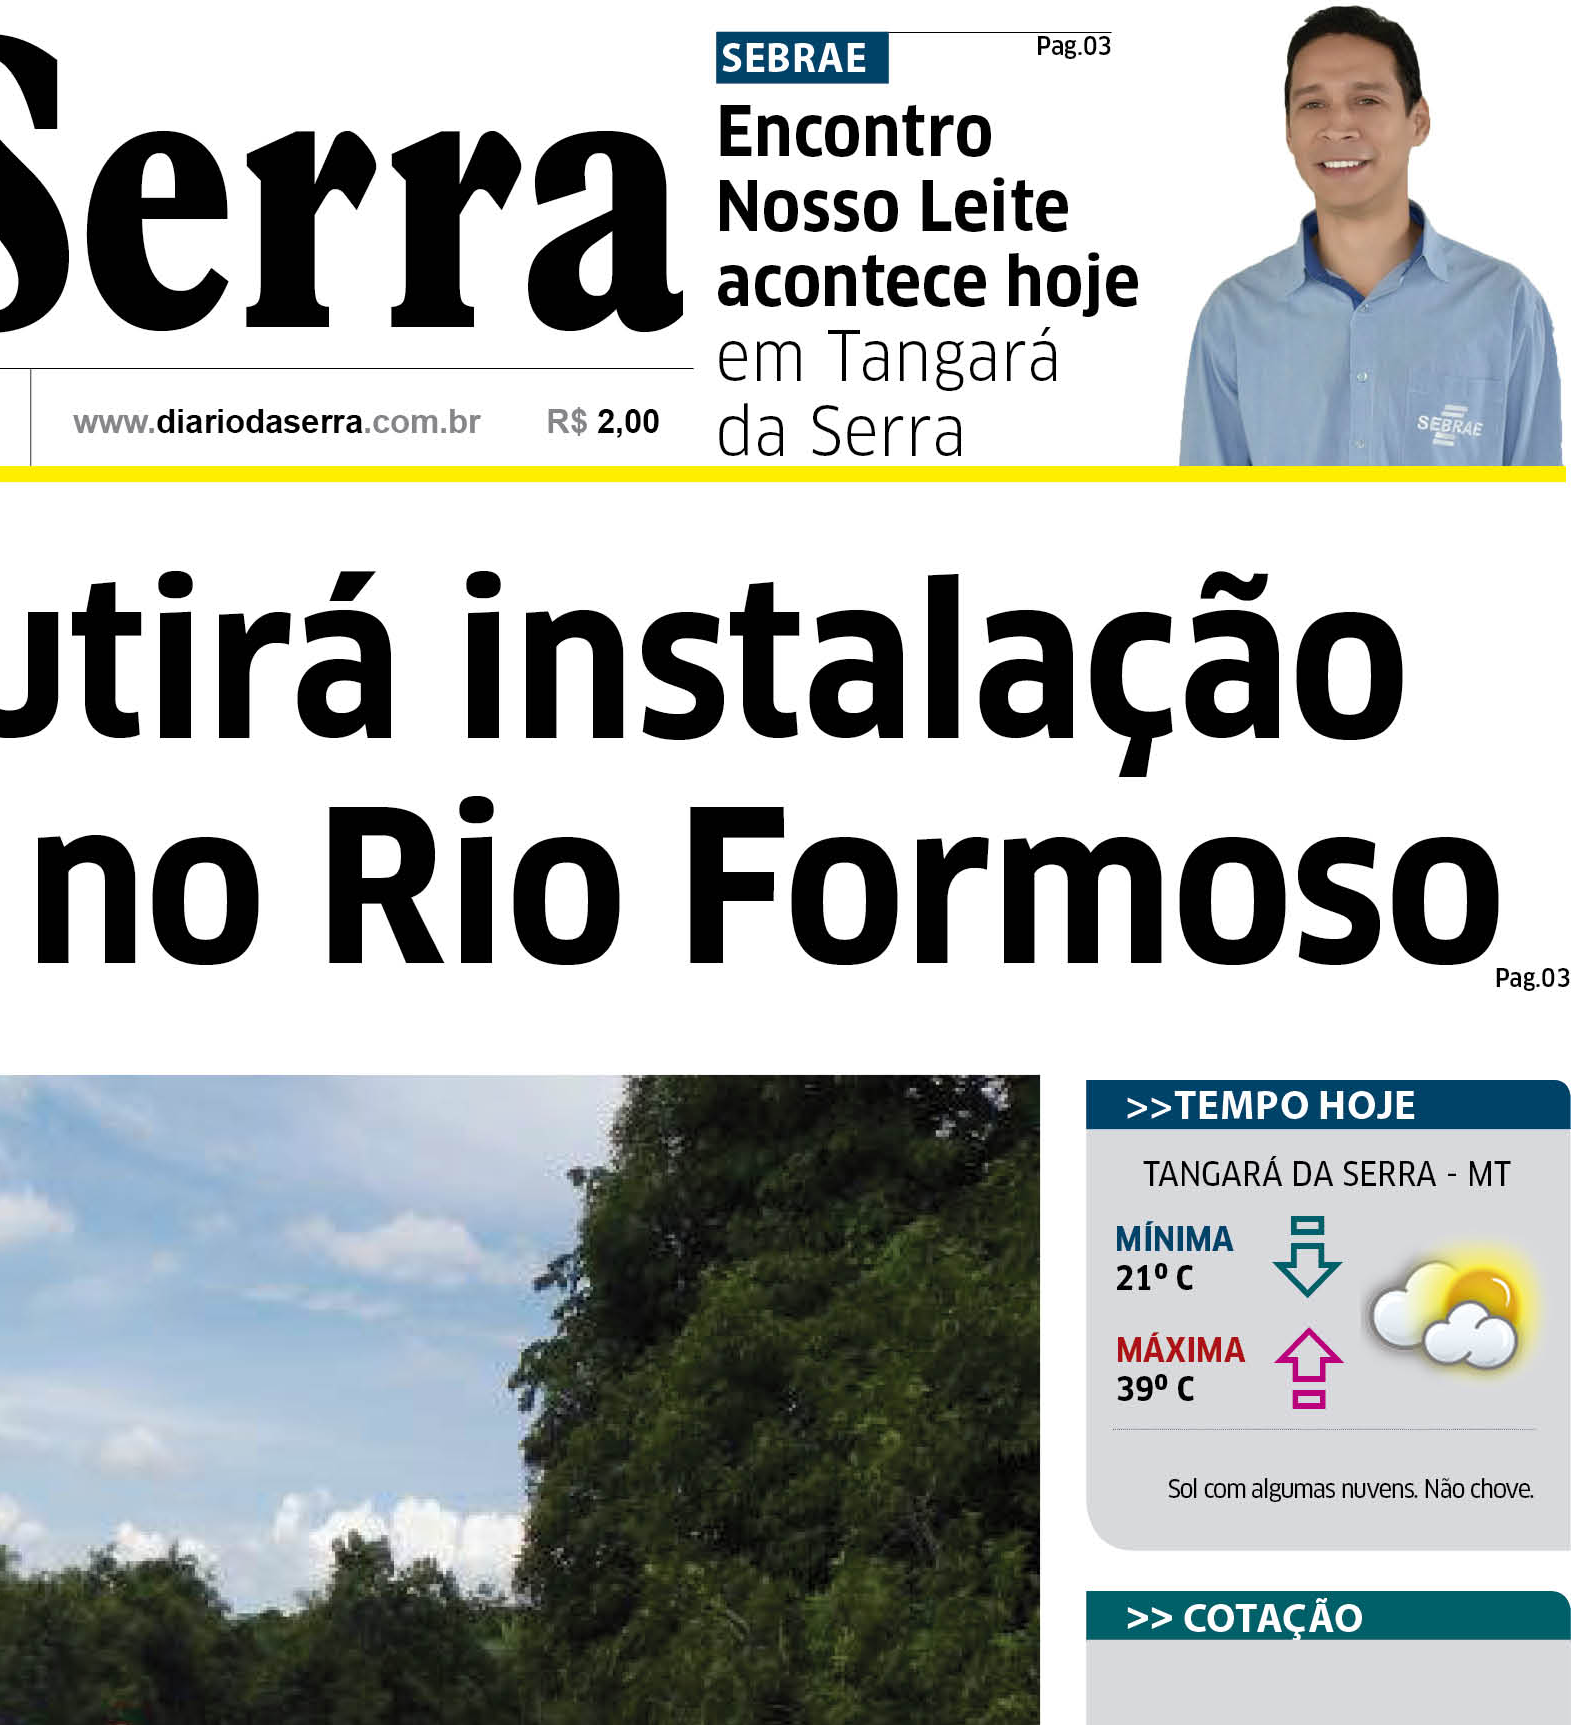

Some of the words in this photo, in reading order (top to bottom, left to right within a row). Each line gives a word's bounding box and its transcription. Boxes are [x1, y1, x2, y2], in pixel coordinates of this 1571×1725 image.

[722, 42, 867, 73] SEBRAE
[1037, 35, 1111, 60] Pag.03
[719, 104, 992, 158] Encontro
[719, 179, 899, 233] Nosso
[921, 176, 1069, 233] Leite
[717, 254, 987, 308] acontece
[1008, 251, 1139, 318] hoje
[718, 340, 802, 382] em
[827, 326, 1057, 392] Tangará
[72, 408, 482, 434] www.diariodaserra.com.br
[548, 406, 588, 437] R$
[597, 408, 660, 439] 2,00
[718, 402, 784, 457] da
[812, 404, 962, 457] Serra
[1416, 415, 1484, 437] SEBRAE
[465, 570, 1404, 778] instalação
[37, 834, 260, 966] no
[328, 795, 621, 966] Rio
[689, 806, 1500, 966] Formoso
[1496, 967, 1570, 992] Pag.03
[1319, 1090, 1416, 1120] HOJE
[1116, 1220, 1235, 1252] MÍNIMA
[1176, 1264, 1194, 1291] C
[1117, 1331, 1246, 1363] MÁXIMA
[1177, 1375, 1195, 1402] C
[1168, 1477, 1197, 1499] Sol
[1204, 1482, 1246, 1499] com
[1251, 1477, 1336, 1503] algumas
[1342, 1482, 1418, 1499] nuvens.
[1425, 1477, 1465, 1499] Não
[1470, 1477, 1534, 1499] chove.
[1184, 1597, 1363, 1641] COTAÇÃO
